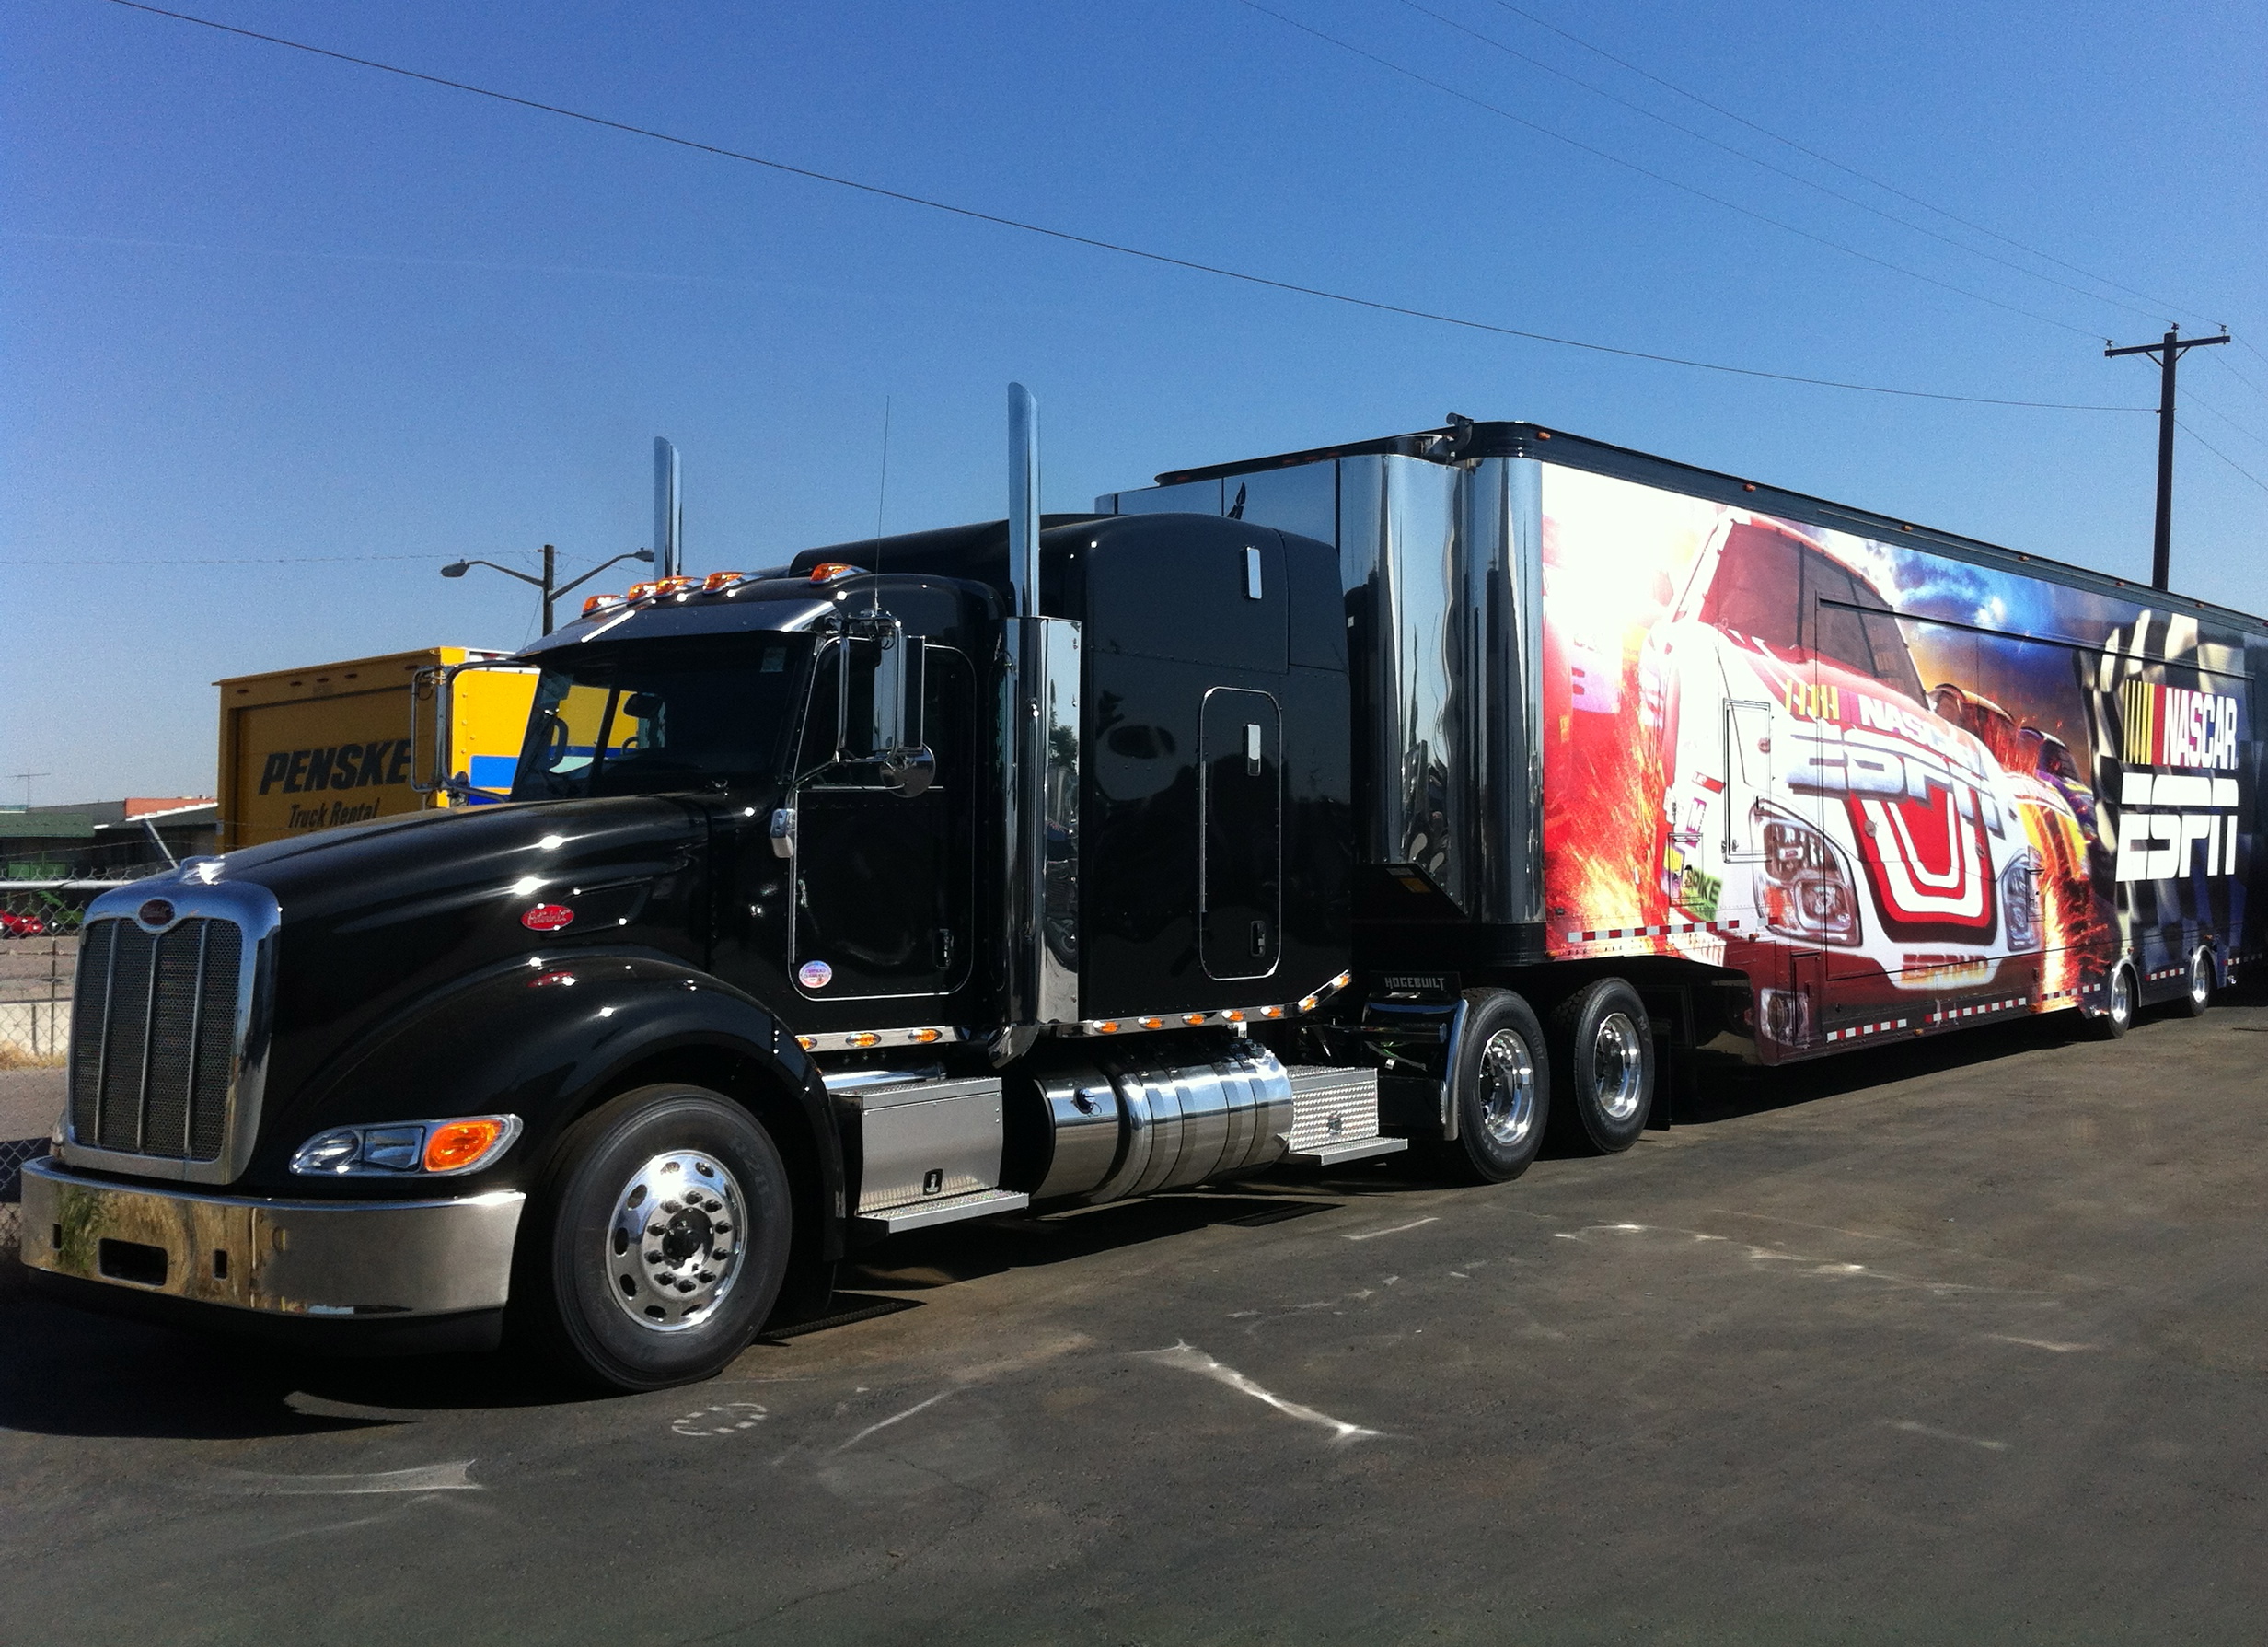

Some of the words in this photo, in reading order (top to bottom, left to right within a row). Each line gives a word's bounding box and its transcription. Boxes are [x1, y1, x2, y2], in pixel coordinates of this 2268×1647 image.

[2163, 687, 2238, 770] NASCAR
[259, 738, 412, 795] PENSKE
[288, 803, 329, 829] Truck
[330, 796, 382, 827] Rental
[2115, 771, 2239, 882] ESPN
[1384, 977, 1444, 992] HOGEBUILT
